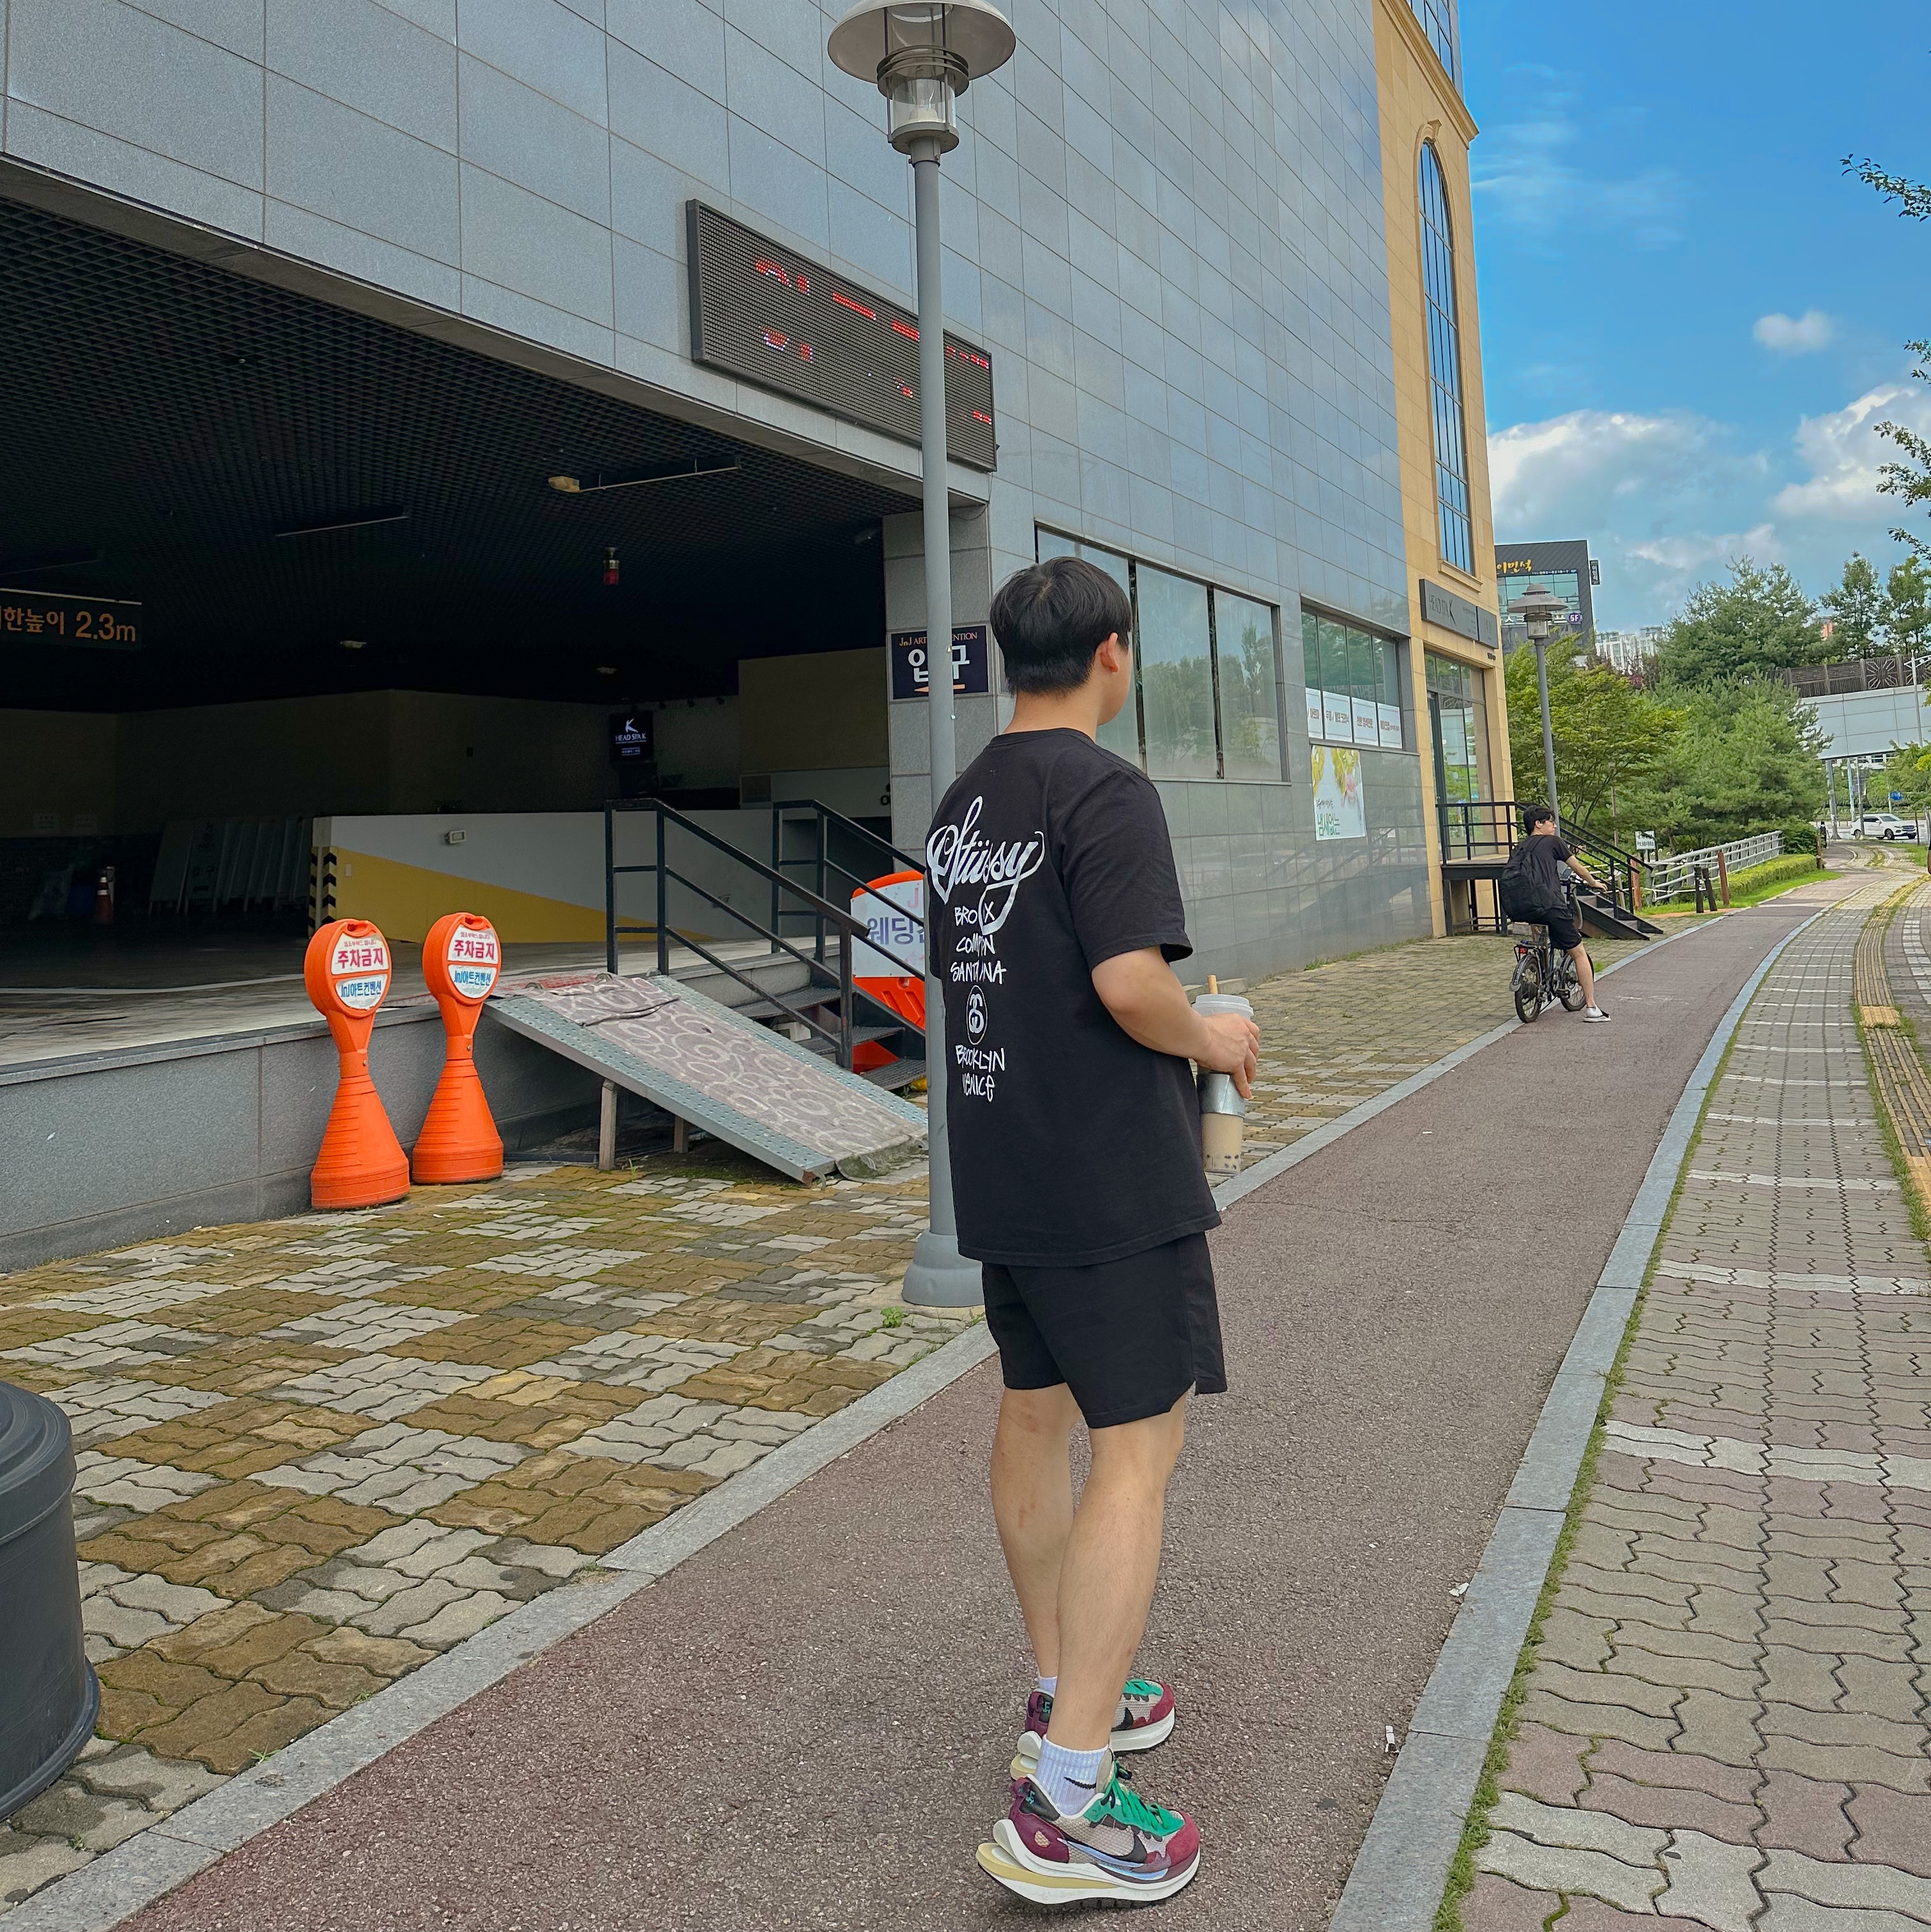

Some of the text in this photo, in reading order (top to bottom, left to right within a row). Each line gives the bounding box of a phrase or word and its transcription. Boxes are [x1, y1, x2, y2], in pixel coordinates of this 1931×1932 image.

[0, 606, 136, 642] 한높이 2.3m
[1569, 614, 1580, 623] 5F
[954, 901, 996, 926] BROX
[867, 917, 925, 946] 웨딩
[338, 947, 383, 969] 주차금지
[454, 939, 495, 960] 주차금지
[955, 1044, 1005, 1073] BROOKLYN
